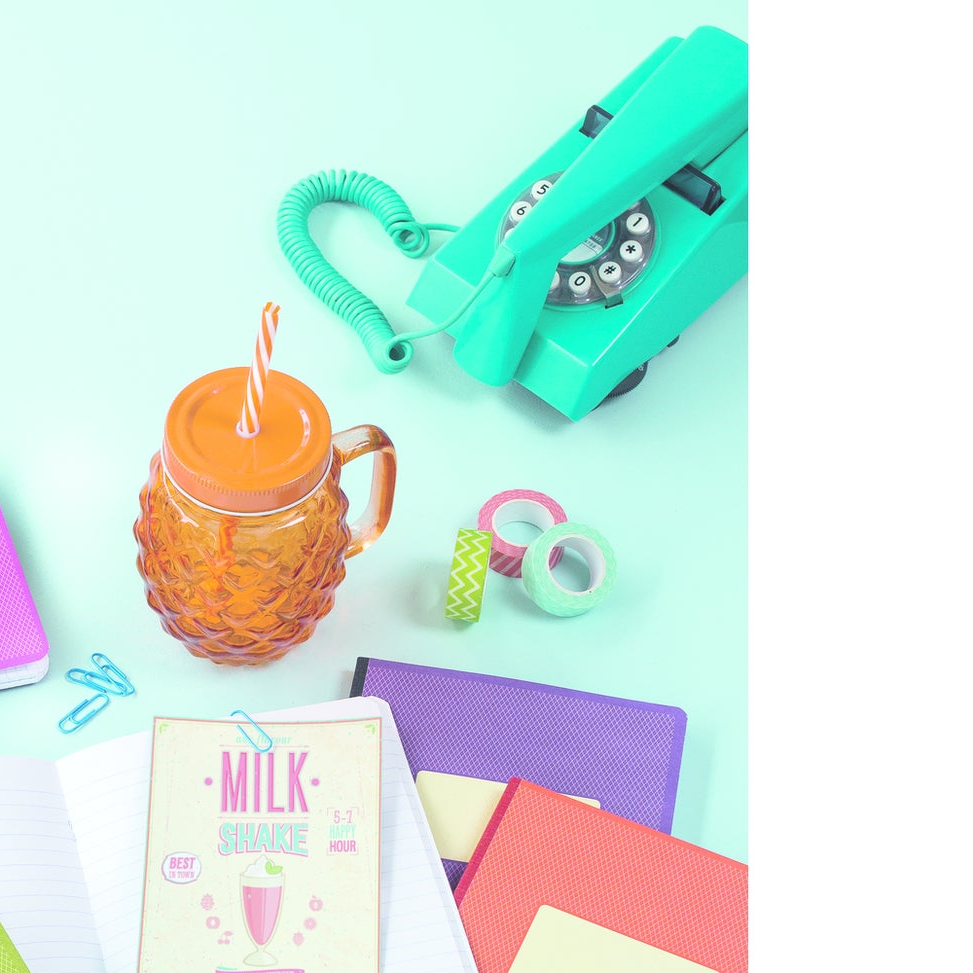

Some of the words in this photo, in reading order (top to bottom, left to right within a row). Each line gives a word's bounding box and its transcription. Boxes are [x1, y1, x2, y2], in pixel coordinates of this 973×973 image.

[536, 184, 549, 195] 5
[516, 205, 527, 216] 6
[632, 217, 643, 227] 1
[574, 275, 586, 286] 0
[221, 751, 308, 813] MILK
[333, 809, 353, 824] 5-7
[329, 824, 356, 840] HAPPY
[217, 822, 309, 858] SHAKE
[329, 840, 356, 853] HOUR
[169, 857, 196, 870] BEST
